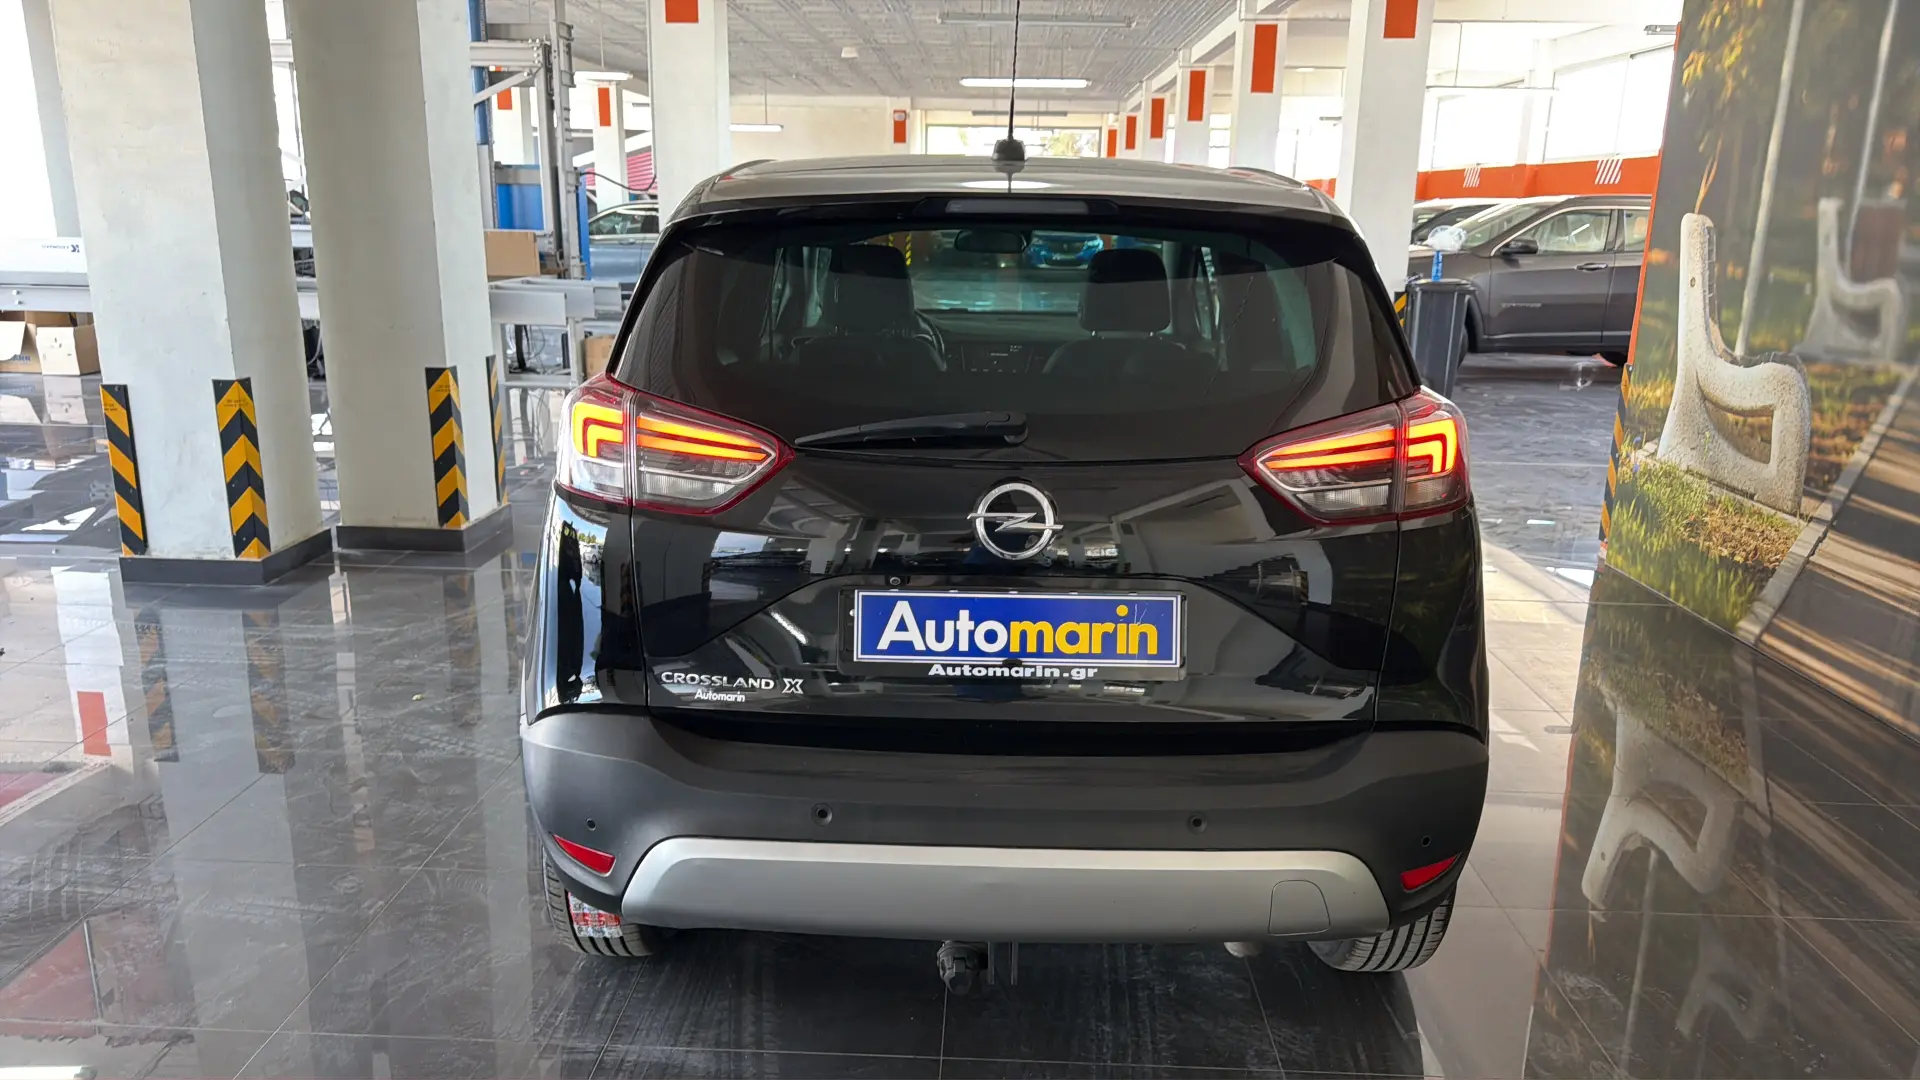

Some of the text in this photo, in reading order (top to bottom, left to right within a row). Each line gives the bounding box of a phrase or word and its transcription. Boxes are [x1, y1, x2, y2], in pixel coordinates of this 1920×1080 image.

[876, 600, 1158, 655] Automarin
[928, 663, 1098, 680] Automarin.gr
[661, 671, 805, 695] CROSSLAND X
[694, 687, 746, 703] Automarin
